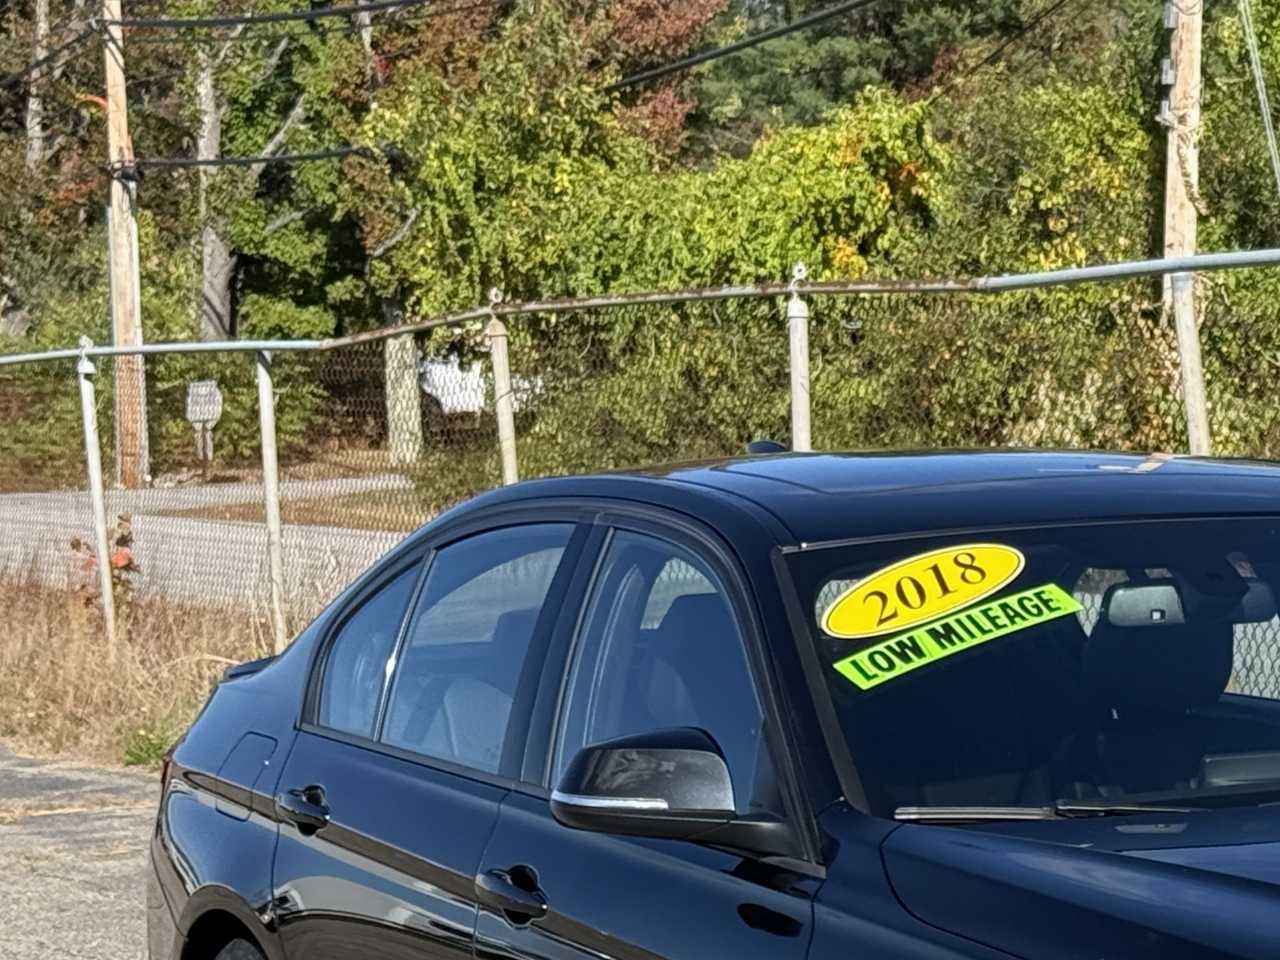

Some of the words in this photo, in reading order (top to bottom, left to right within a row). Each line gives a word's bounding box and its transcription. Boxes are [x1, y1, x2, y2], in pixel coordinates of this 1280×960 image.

[862, 552, 988, 627] 2018
[850, 636, 927, 682] LOW
[925, 590, 1061, 650] MILEAGE
